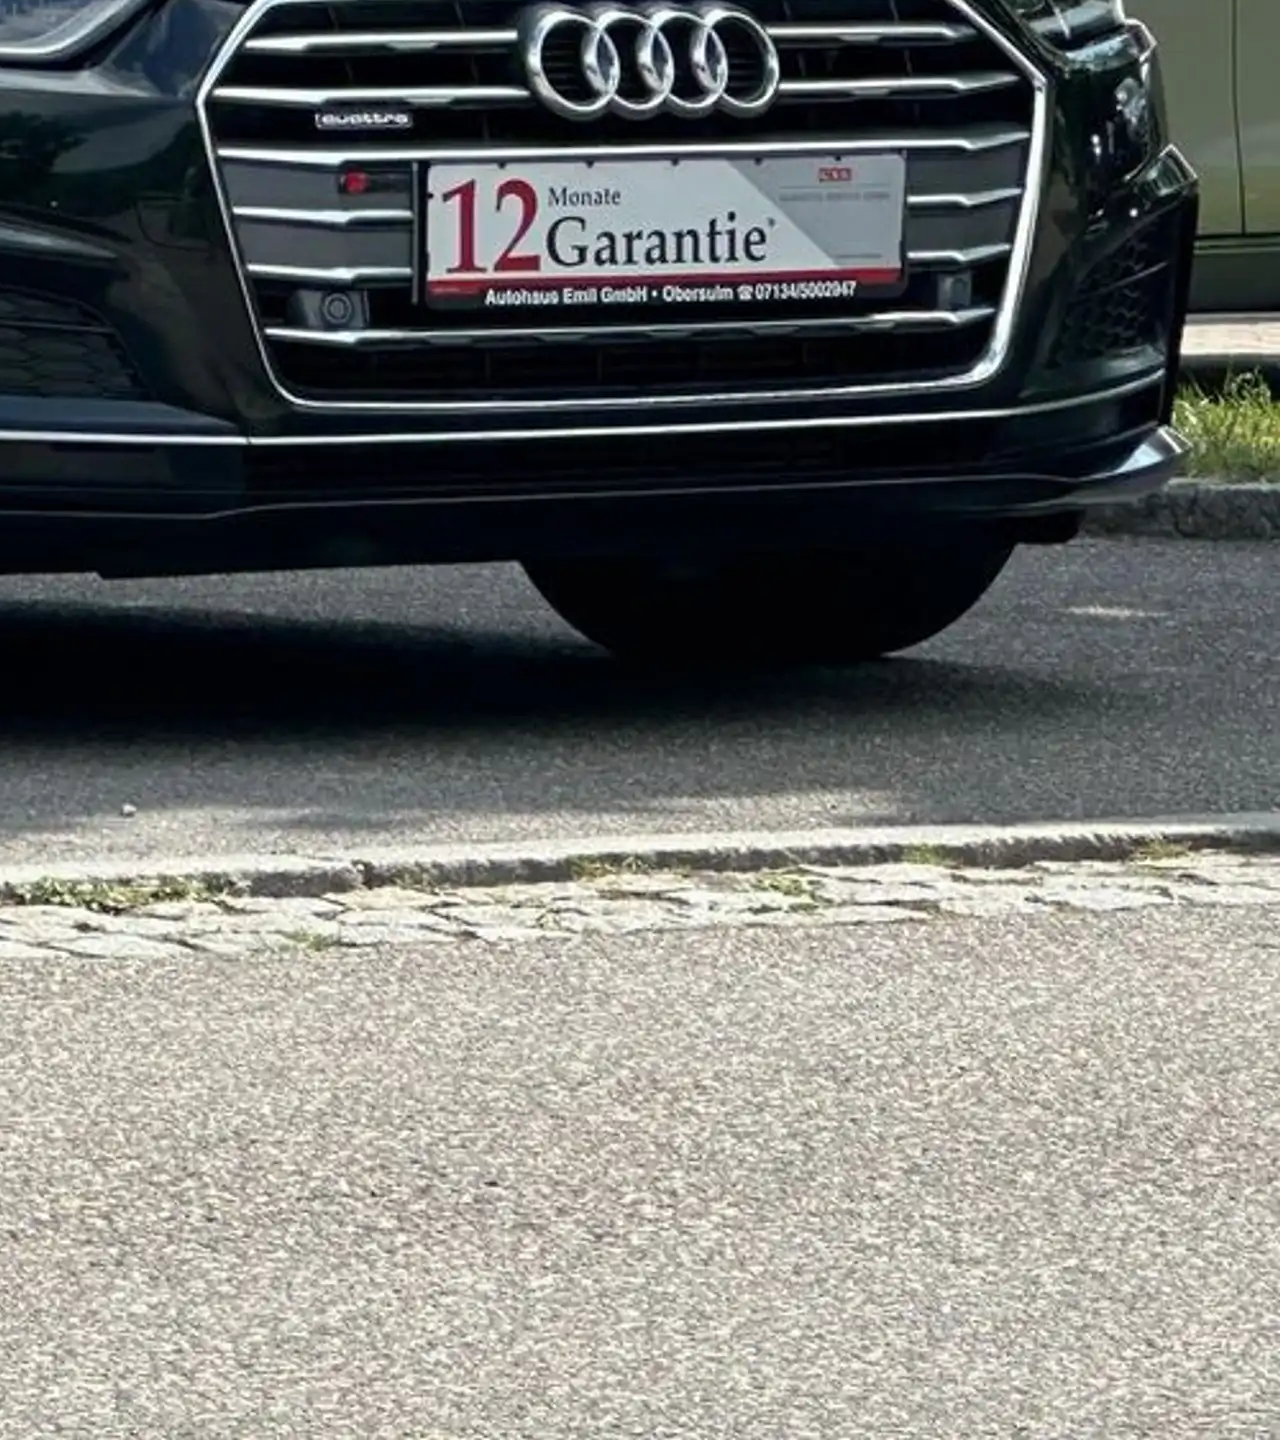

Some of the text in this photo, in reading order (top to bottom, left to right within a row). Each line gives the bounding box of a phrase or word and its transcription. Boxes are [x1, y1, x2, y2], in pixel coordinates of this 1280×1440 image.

[548, 186, 622, 207] Monate
[442, 178, 541, 274] 12
[485, 288, 559, 305] Autohaus
[562, 287, 597, 303] Emil
[600, 285, 648, 303] GmbH
[663, 285, 734, 302] Obersulm
